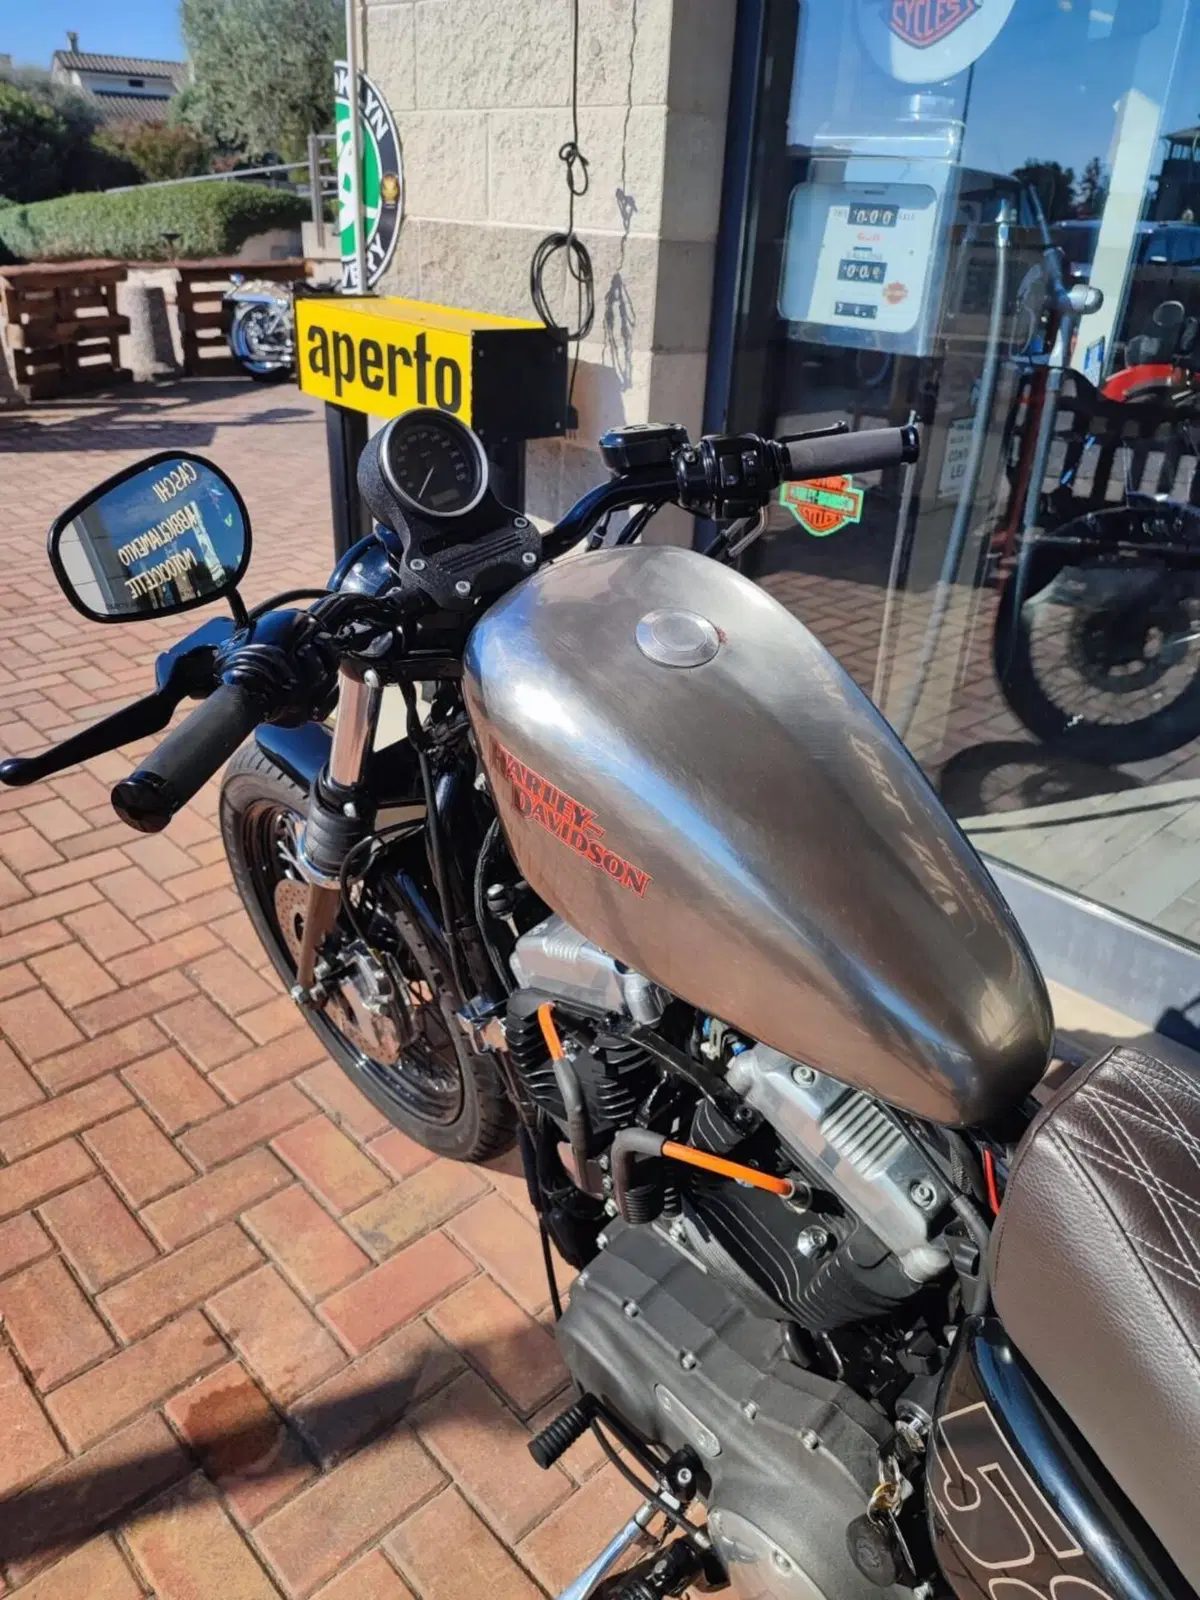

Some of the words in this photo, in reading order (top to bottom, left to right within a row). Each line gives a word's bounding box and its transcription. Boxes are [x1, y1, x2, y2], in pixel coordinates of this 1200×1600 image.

[891, 0, 965, 38] CYCLES
[307, 324, 462, 414] aperto
[511, 782, 654, 898] DAVIDSON
